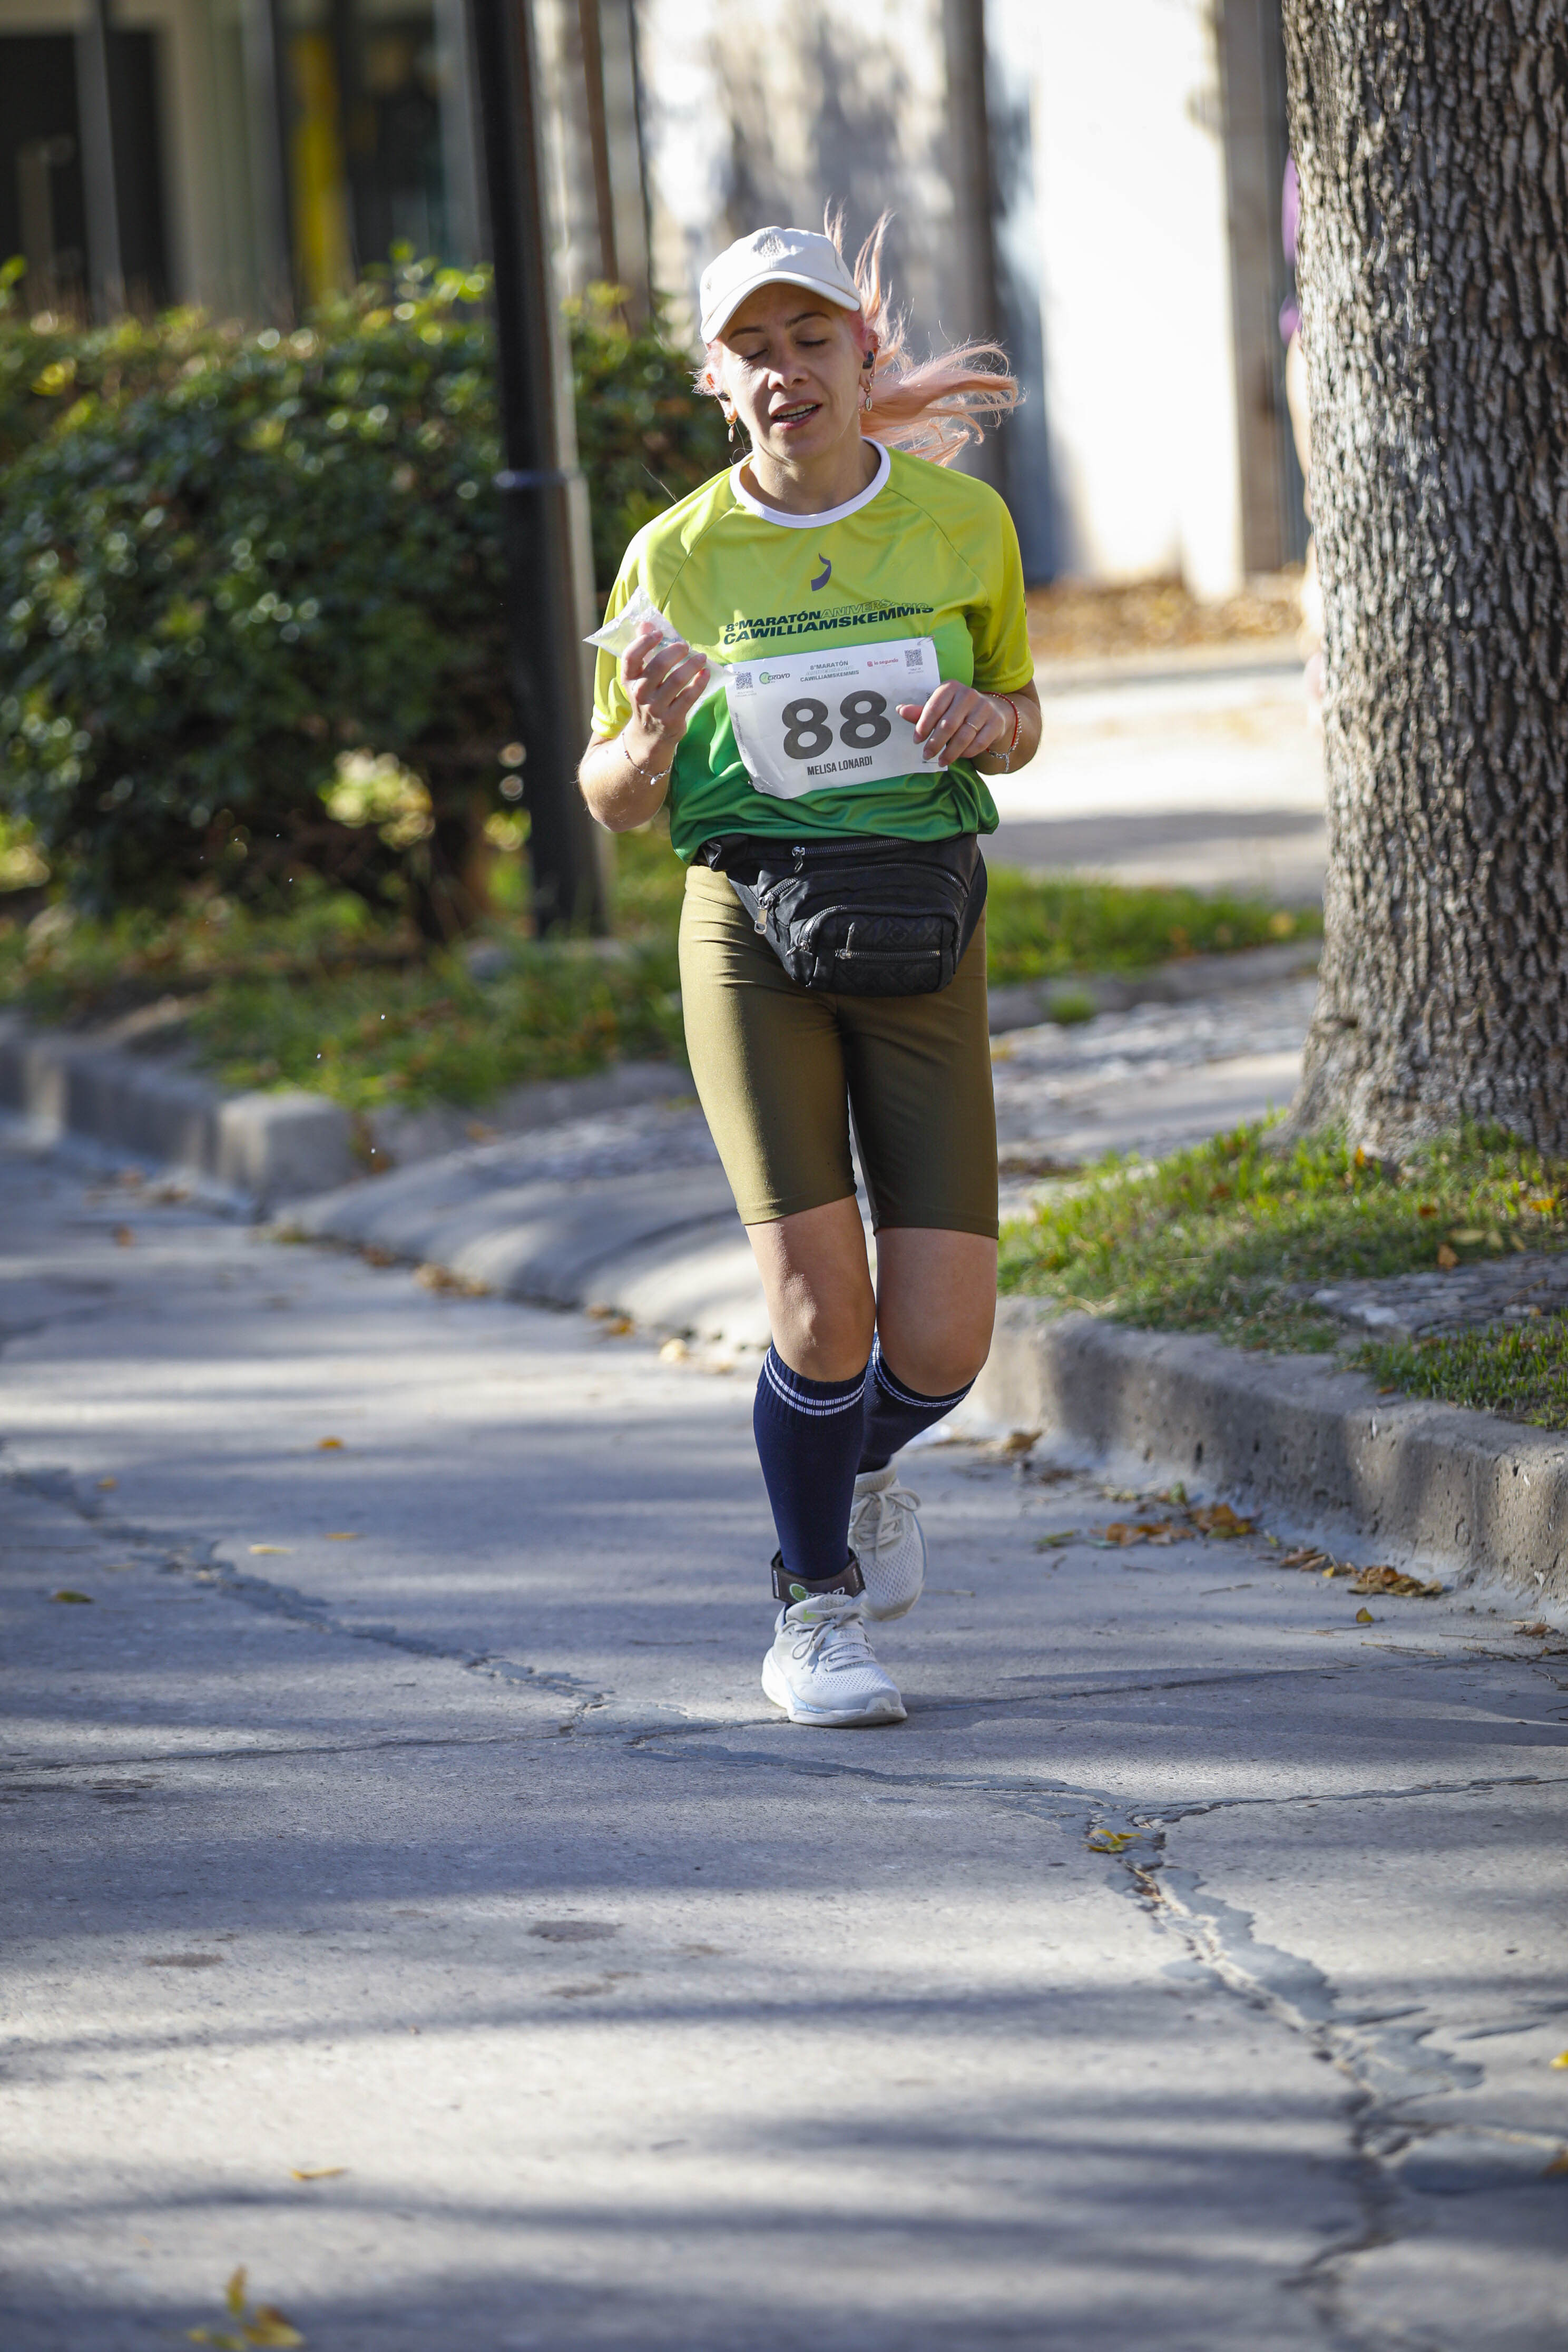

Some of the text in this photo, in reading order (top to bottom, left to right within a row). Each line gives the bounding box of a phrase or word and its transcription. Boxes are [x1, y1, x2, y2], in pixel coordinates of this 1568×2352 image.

[800, 669, 859, 682] CAWILLIAMSKEMMIS
[782, 690, 891, 760] 88
[807, 756, 873, 776] MELISA LONARDI
